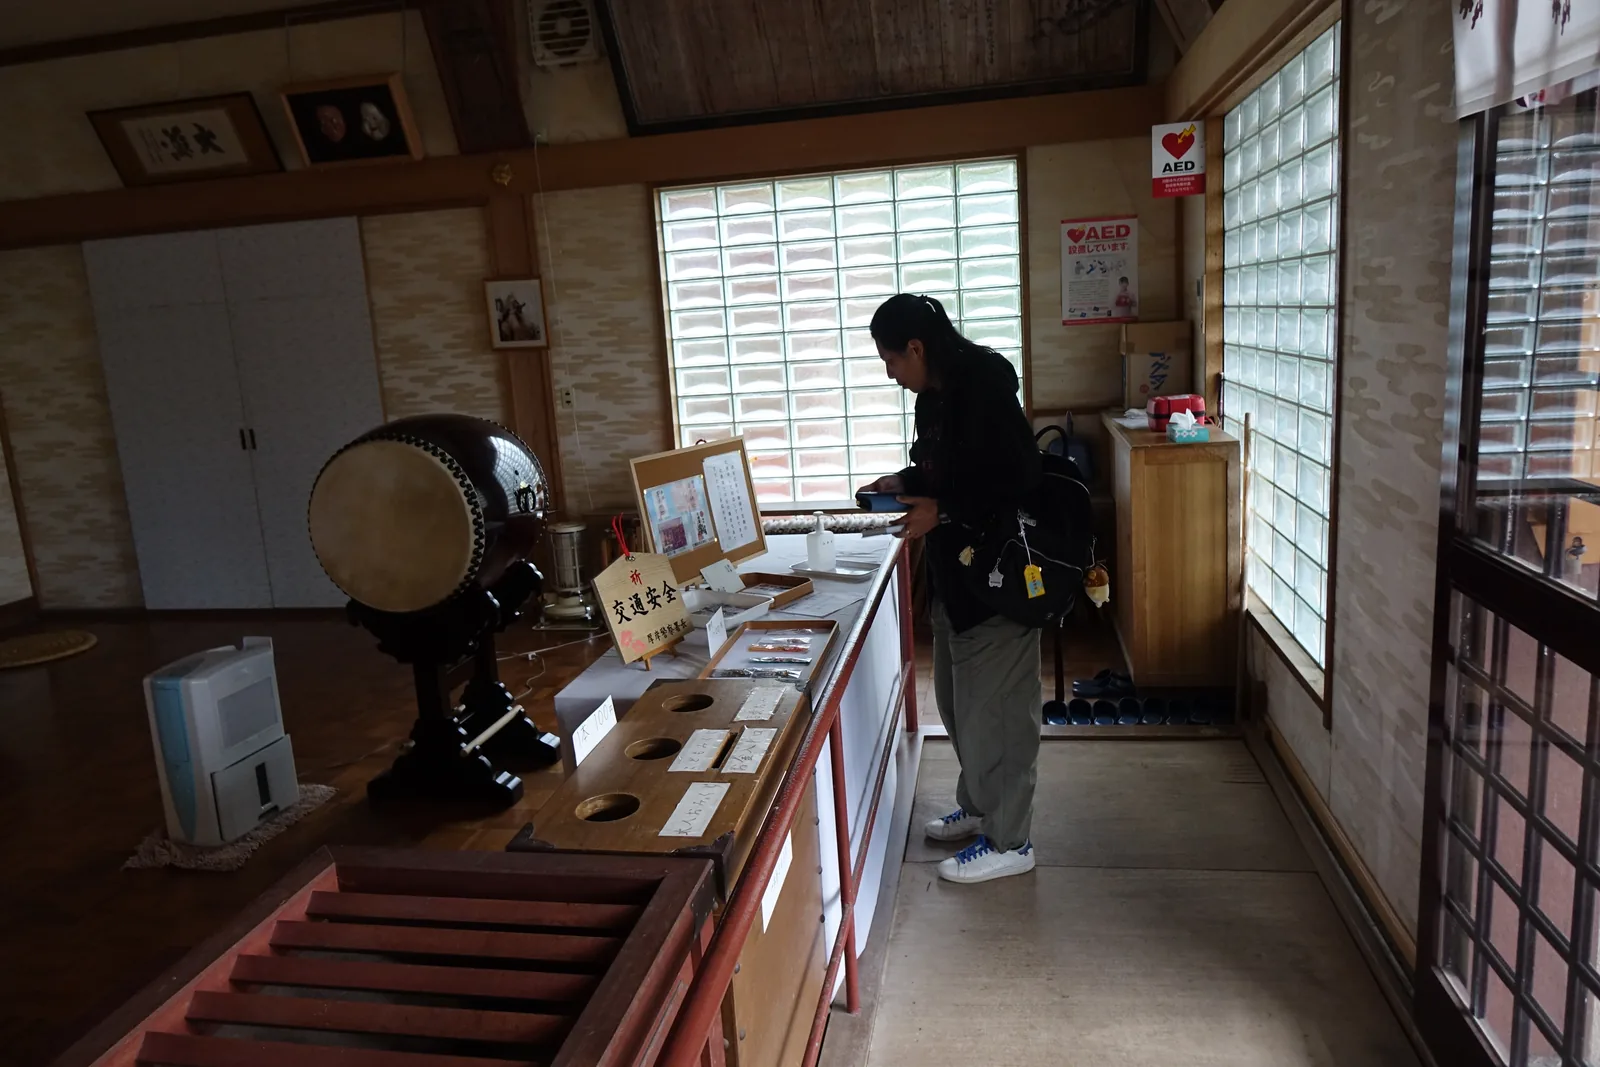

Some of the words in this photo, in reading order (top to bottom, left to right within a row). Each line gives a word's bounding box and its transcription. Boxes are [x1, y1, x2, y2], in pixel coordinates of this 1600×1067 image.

[1162, 160, 1196, 173] AED
[1085, 224, 1131, 241] AED
[629, 568, 643, 586] 祈
[612, 580, 677, 625] 交通安全
